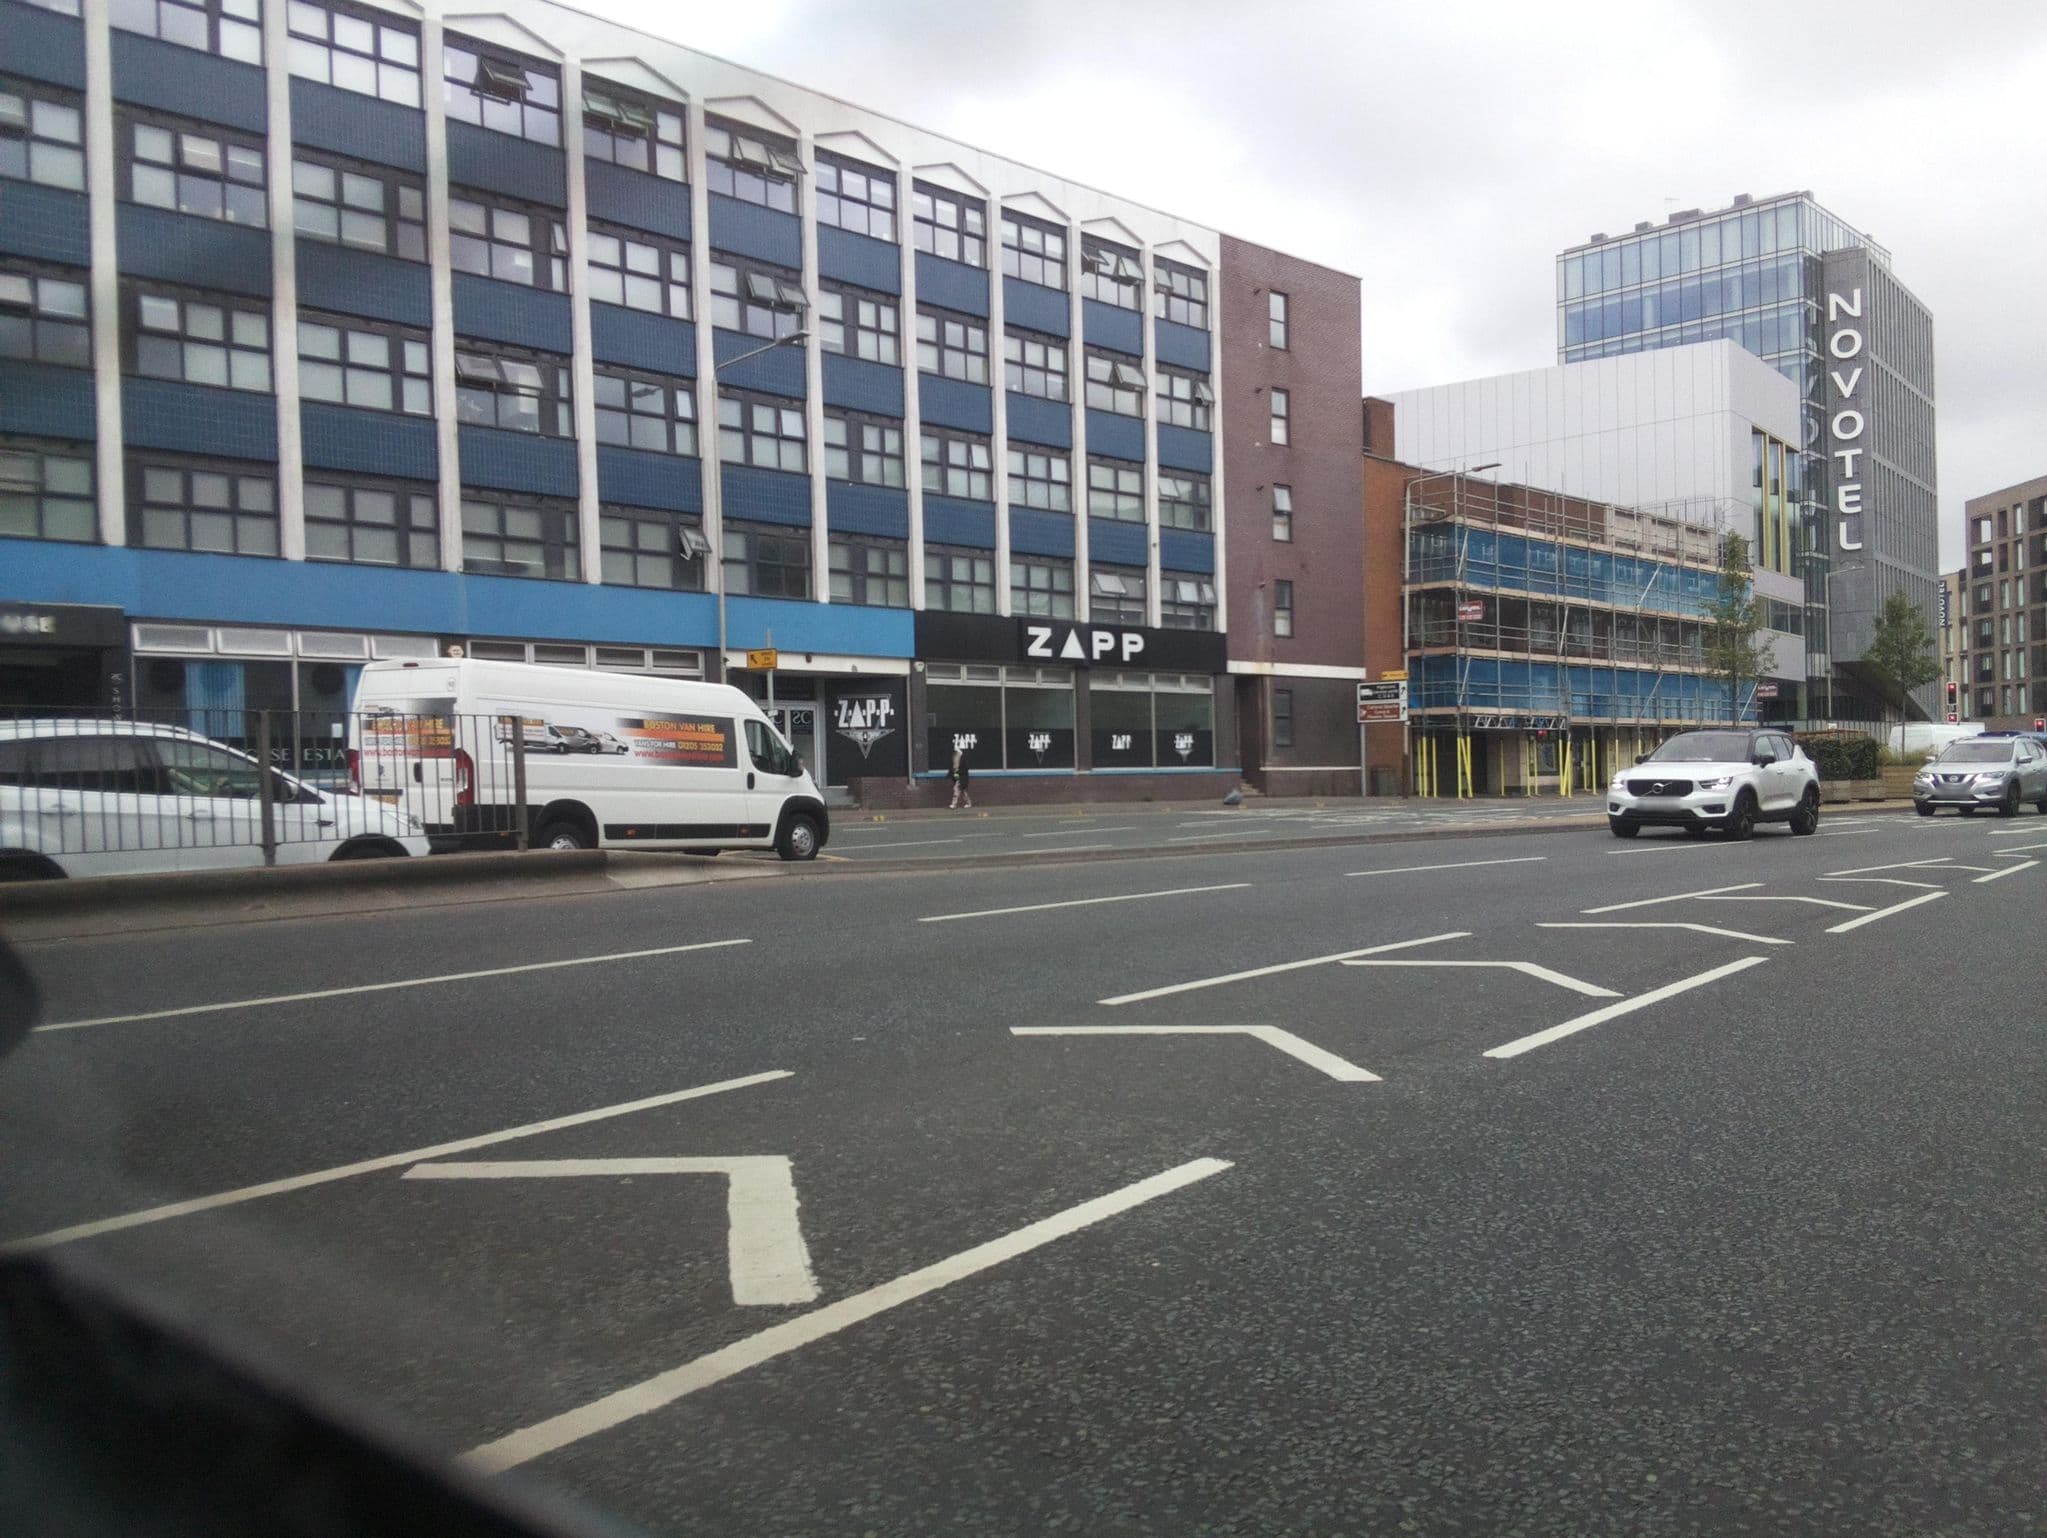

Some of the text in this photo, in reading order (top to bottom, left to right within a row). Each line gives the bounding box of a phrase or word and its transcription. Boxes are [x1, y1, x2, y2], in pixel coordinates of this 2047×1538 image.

[1828, 288, 1864, 550] NOVOTEL
[1938, 580, 1946, 626] NOVOTEL
[1027, 626, 1145, 661] ZAPP
[643, 719, 716, 733] BOSTON VAN HIRE
